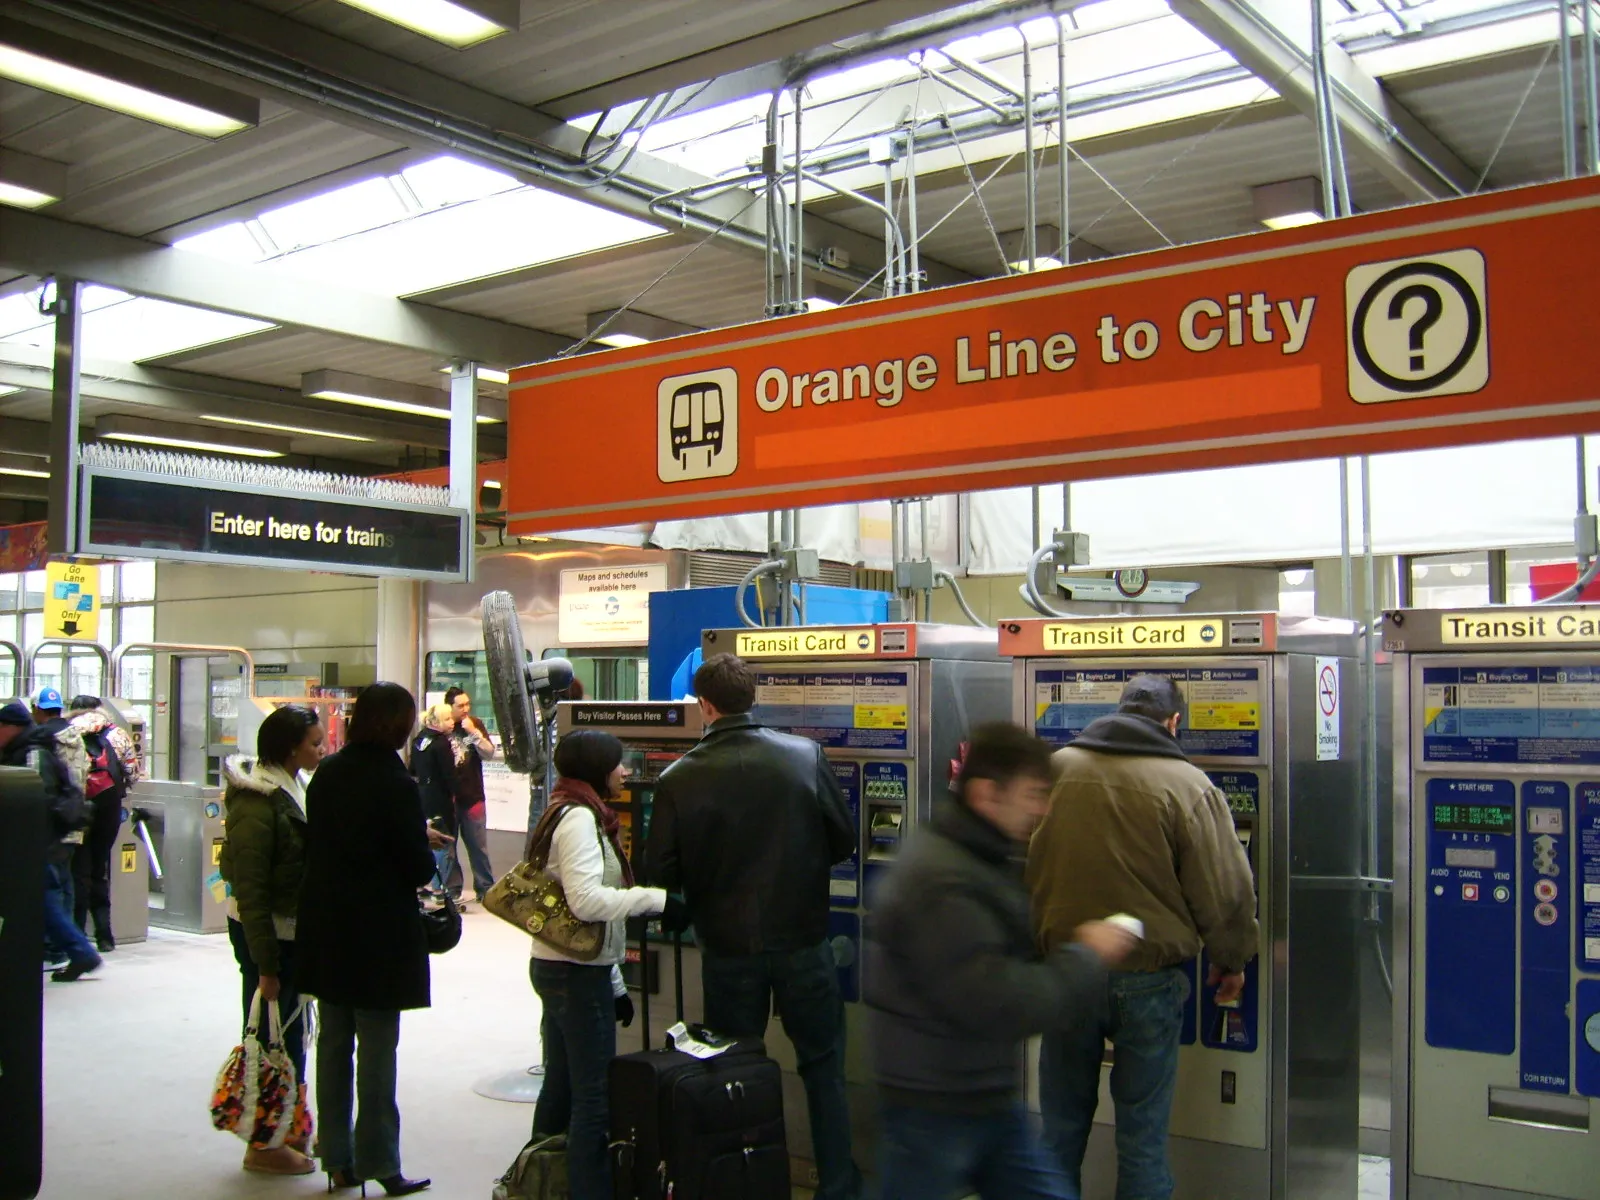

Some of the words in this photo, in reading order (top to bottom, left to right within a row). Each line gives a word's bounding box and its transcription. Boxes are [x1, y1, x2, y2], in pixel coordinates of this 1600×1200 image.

[755, 353, 938, 412] Orange
[955, 331, 1077, 384] Line
[1097, 315, 1159, 363] to
[1179, 293, 1317, 355] City
[210, 511, 264, 537] Enter
[268, 516, 311, 541] here
[315, 521, 341, 543] for
[345, 525, 395, 548] trains
[69, 565, 81, 574] Go
[64, 573, 85, 583] Lane
[578, 573, 596, 582] Maps
[597, 572, 611, 580] and
[613, 570, 649, 579] schedules
[588, 583, 619, 593] available
[620, 582, 637, 591] here
[61, 610, 82, 622] Only
[1447, 617, 1546, 638] Transit
[1557, 615, 1600, 637] Ca
[1049, 625, 1124, 645] Transit
[1132, 624, 1186, 643] Card
[741, 635, 799, 653] Transit
[805, 634, 847, 651] Card
[1513, 673, 1528, 681] Card
[577, 712, 592, 721] Buy
[593, 712, 615, 720] Visitor
[616, 712, 642, 720] Passes
[644, 712, 661, 720] Here
[1325, 720, 1332, 732] No
[1319, 733, 1337, 748] Smoking
[1535, 785, 1555, 794] COINS
[1431, 868, 1449, 876] AUDIO
[1459, 870, 1482, 879] CANCEL
[1494, 872, 1510, 880] VEND
[1523, 1072, 1540, 1082] COIN
[1540, 1075, 1566, 1085] RETURN
